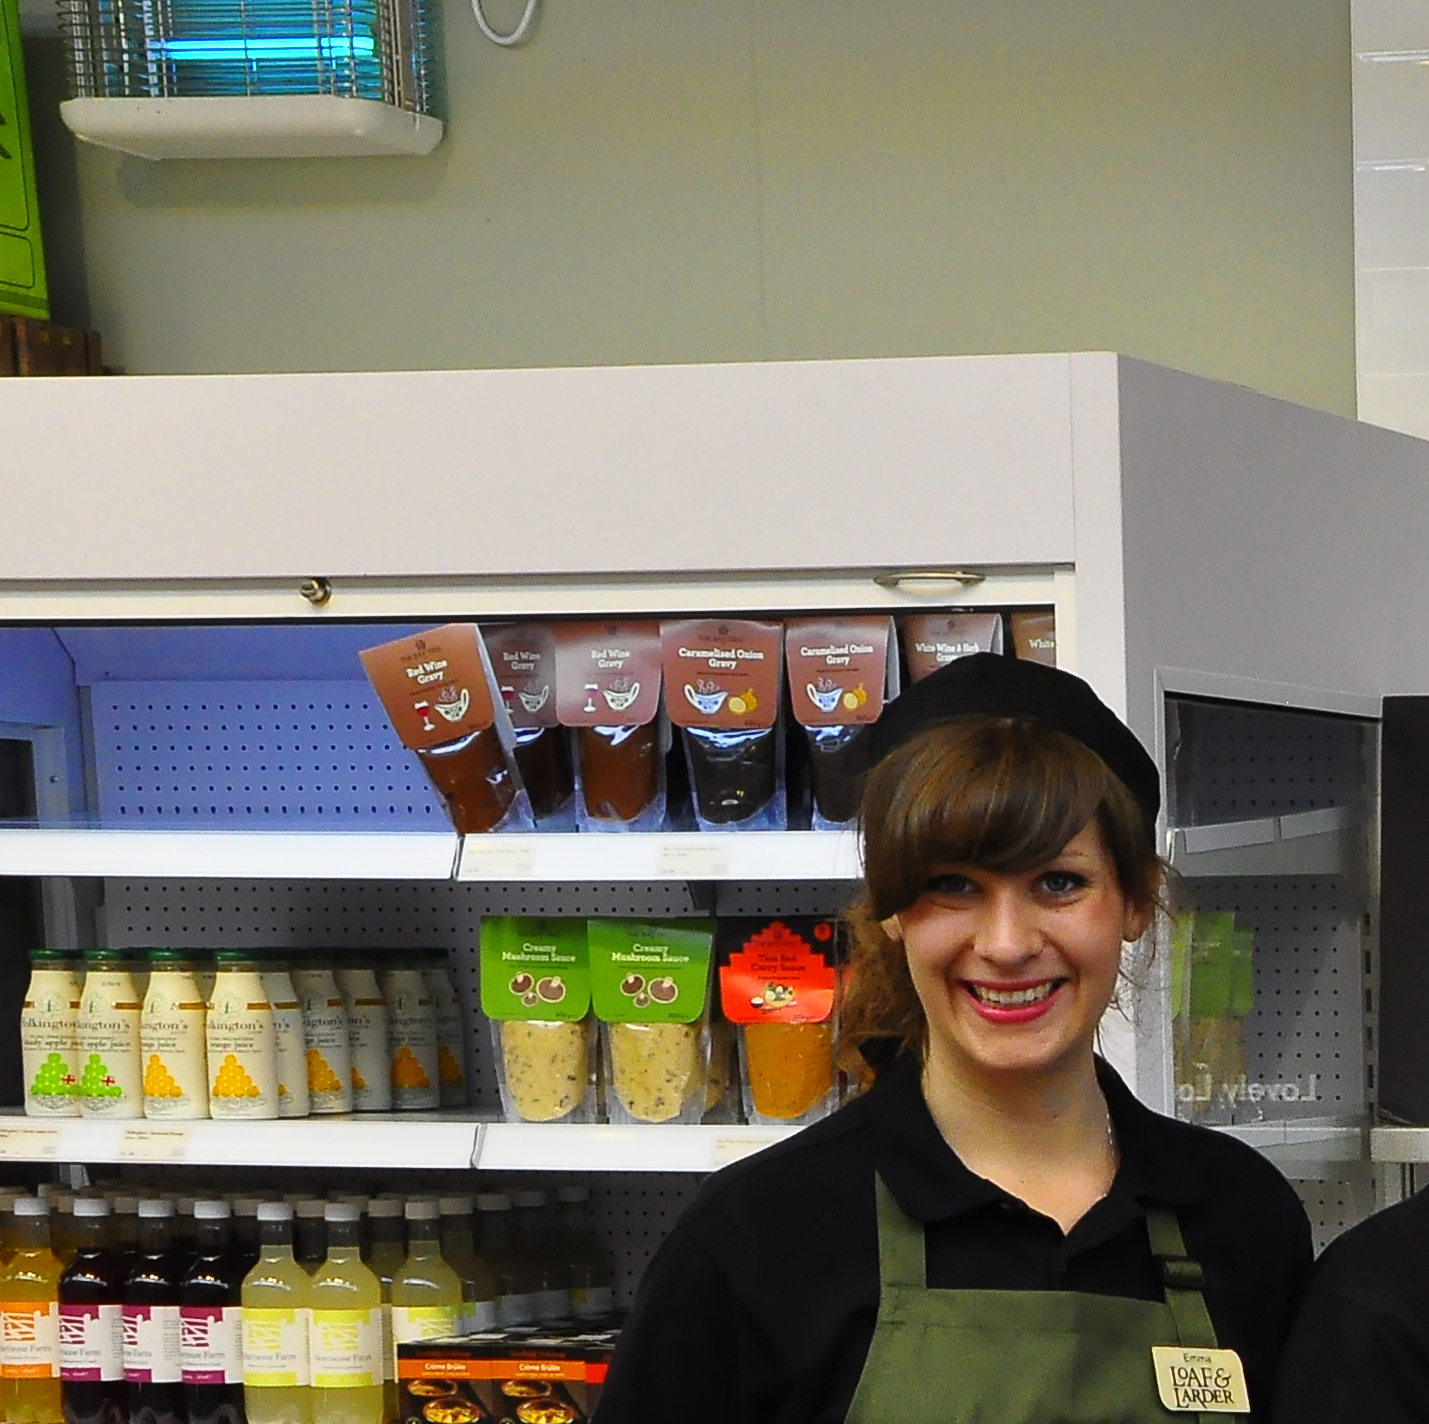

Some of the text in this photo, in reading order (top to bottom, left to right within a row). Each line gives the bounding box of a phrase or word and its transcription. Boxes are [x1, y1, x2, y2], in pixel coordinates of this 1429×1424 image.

[678, 646, 764, 660] Caramelised Onion
[406, 659, 448, 678] Red Wine
[708, 657, 737, 669] Gravy
[417, 670, 444, 685] Gravy
[633, 943, 669, 955] Creamy
[612, 952, 690, 963] Mushroom Sauce
[1183, 1353, 1212, 1363] Emma
[1170, 1366, 1213, 1388] LOAF
[1173, 1388, 1234, 1408] LARDER
